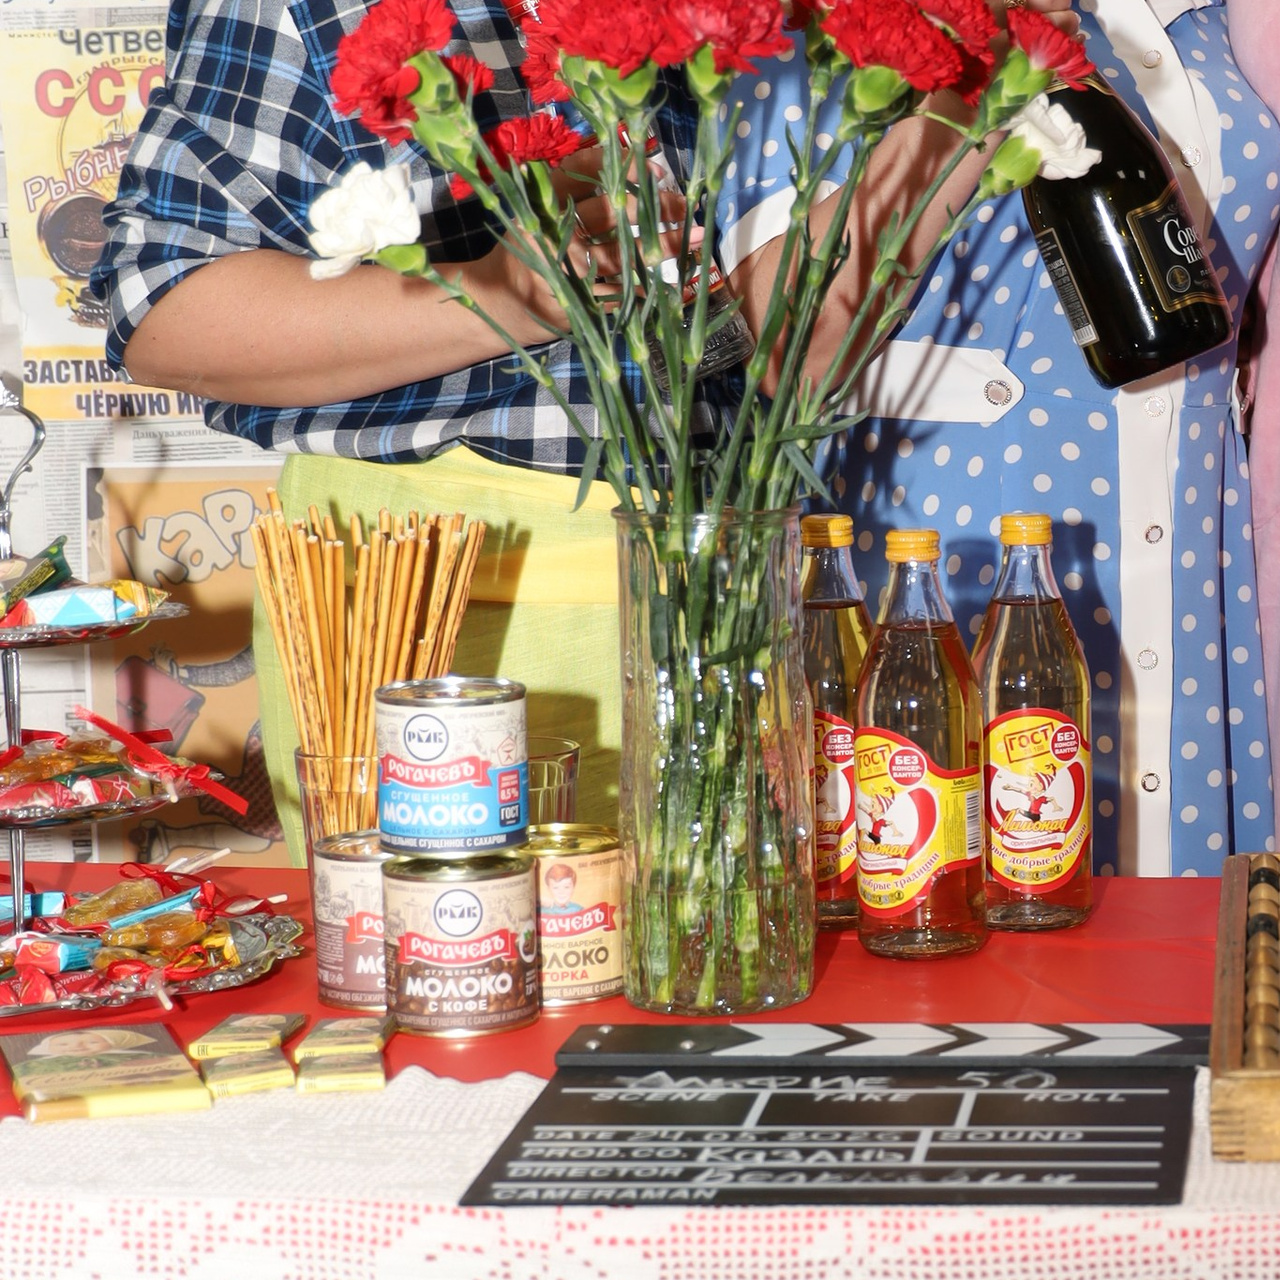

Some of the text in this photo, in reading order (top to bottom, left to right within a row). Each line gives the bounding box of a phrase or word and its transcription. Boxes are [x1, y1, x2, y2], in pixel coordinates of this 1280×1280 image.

[76, 389, 170, 418] ЧЁРНУЮ
[828, 734, 852, 744] БЕЗ
[1007, 727, 1050, 752] ГОСТ
[1056, 731, 1076, 741] БЕЗ
[858, 748, 888, 770] ГОСТ
[894, 755, 919, 765] БЕЗ
[383, 801, 490, 827] МОЛОКО
[500, 805, 520, 821] ГОСТ
[995, 807, 1068, 834] Лимонад
[1008, 856, 1051, 869] добрые
[404, 971, 514, 999] МОЛОКО
[427, 999, 489, 1013] С КОФЕ
[590, 1091, 728, 1103] SCENE
[813, 1091, 916, 1103] TAKE
[1022, 1091, 1128, 1103] ROLL
[534, 1130, 613, 1141] DATE
[938, 1130, 1084, 1142] SOUND
[506, 1166, 684, 1179] DIRECTOR
[492, 1187, 720, 1201] CAMERAMAN
